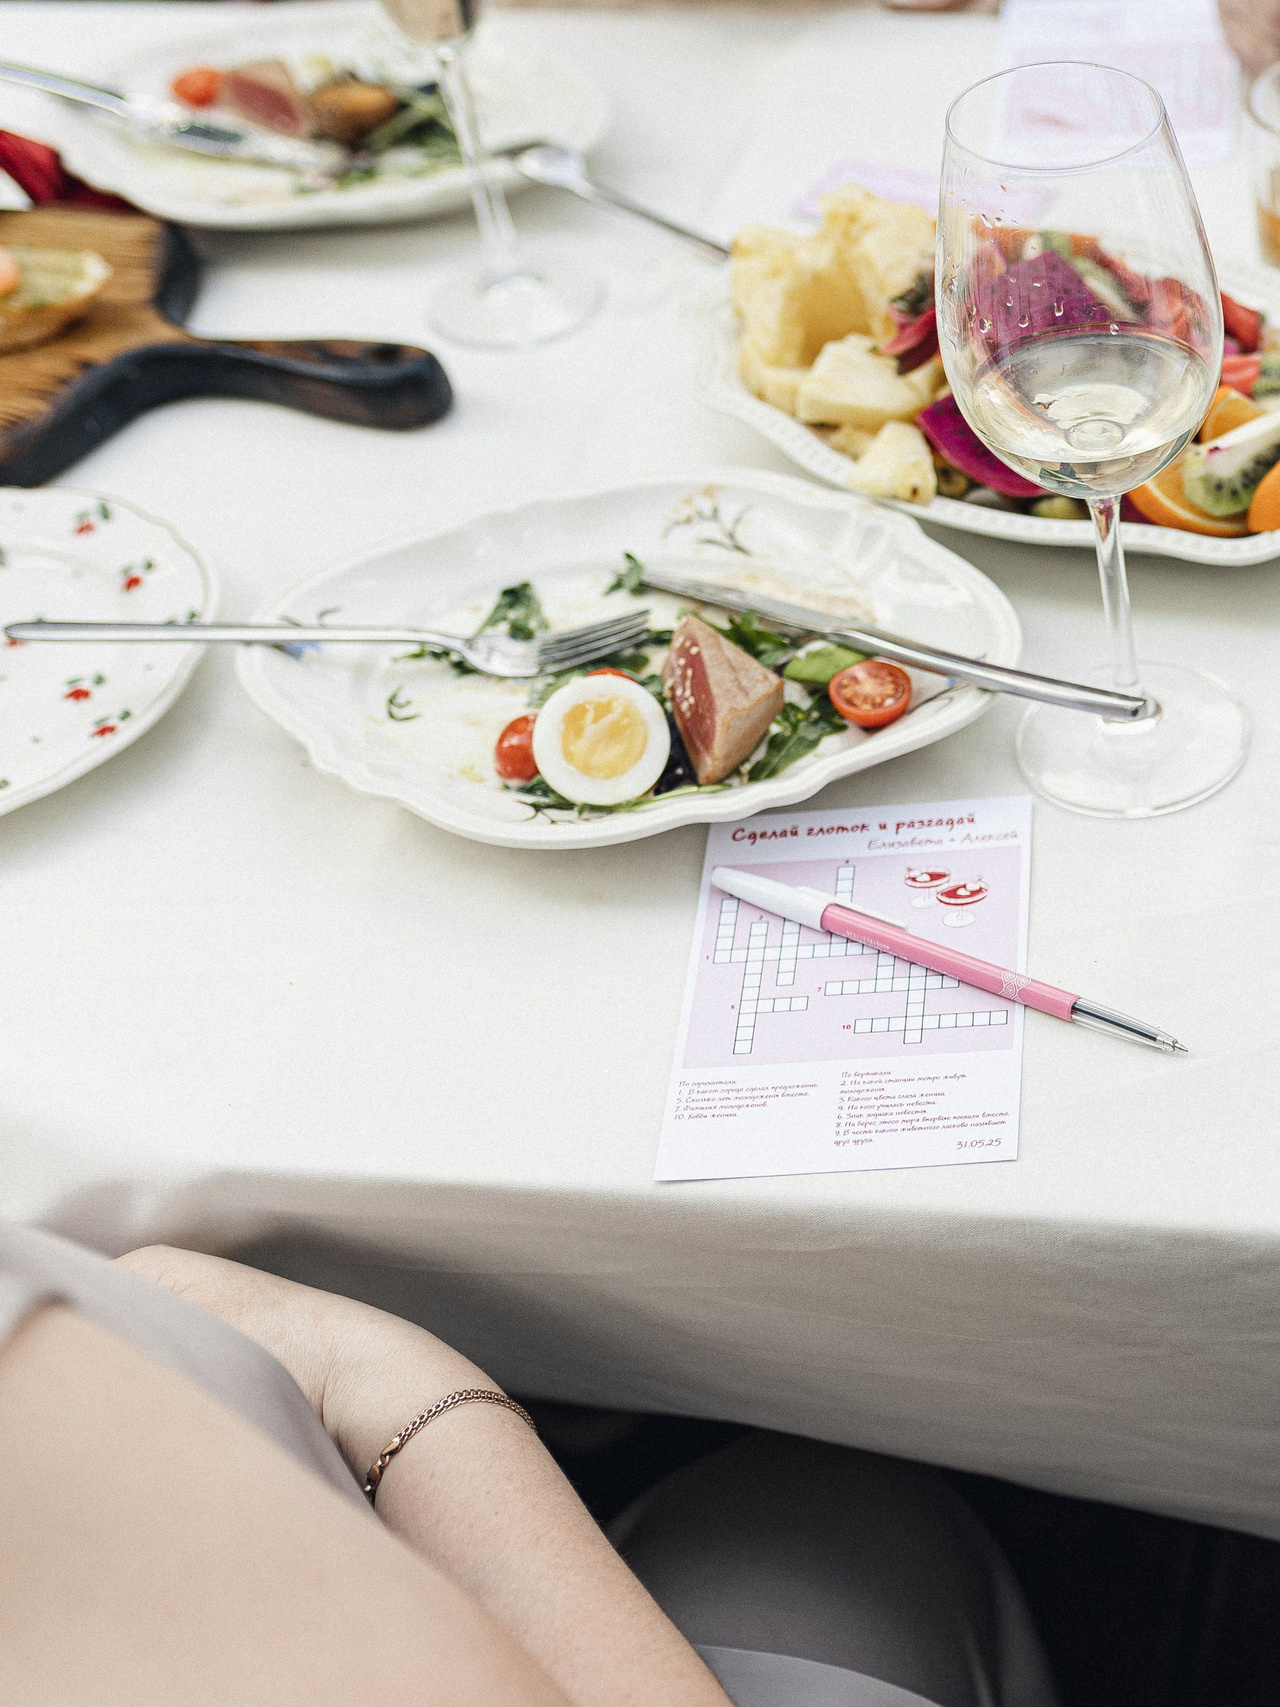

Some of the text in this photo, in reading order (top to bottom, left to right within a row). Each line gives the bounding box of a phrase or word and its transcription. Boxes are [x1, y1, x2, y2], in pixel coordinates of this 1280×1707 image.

[732, 813, 976, 845] Сделай глоток и разгадай
